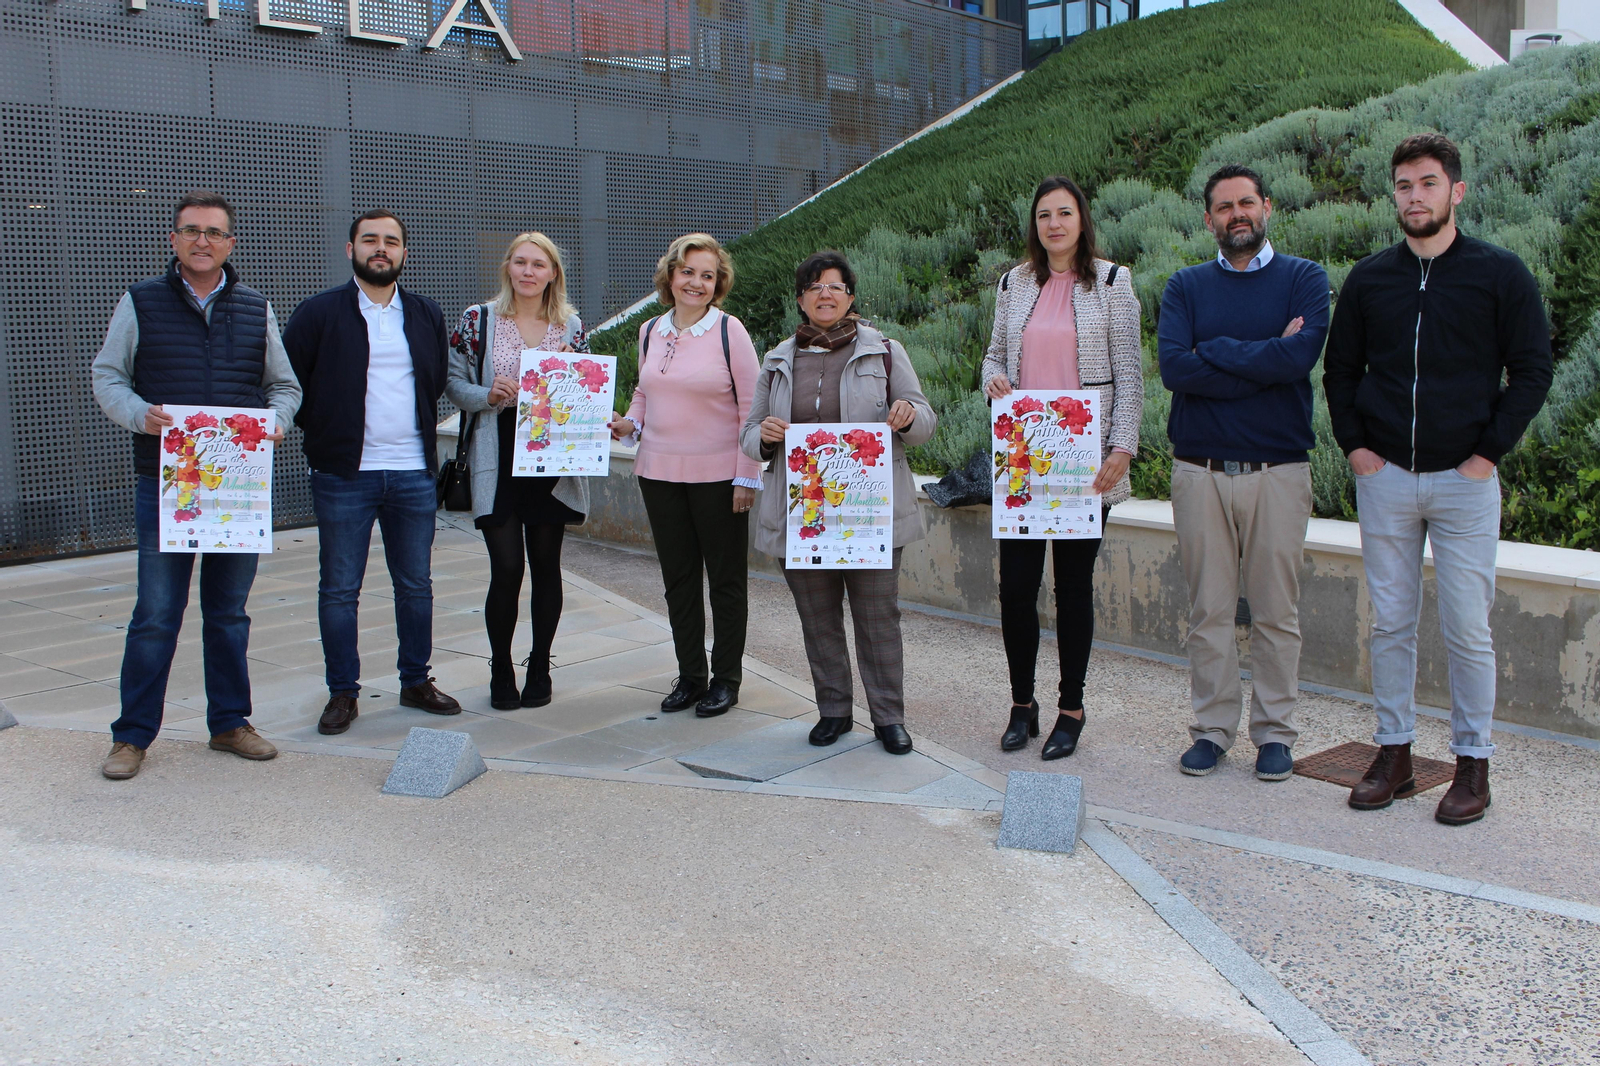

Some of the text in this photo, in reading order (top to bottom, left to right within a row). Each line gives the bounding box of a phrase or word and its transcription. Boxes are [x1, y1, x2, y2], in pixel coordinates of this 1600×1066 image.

[1059, 437, 1072, 448] de
[1033, 438, 1096, 463] Bodega
[230, 453, 244, 464] de
[852, 469, 865, 480] de
[1053, 460, 1095, 477] Montilla
[222, 475, 264, 491] Montilla
[826, 469, 888, 495] Bodega
[845, 492, 886, 507] Montilla
